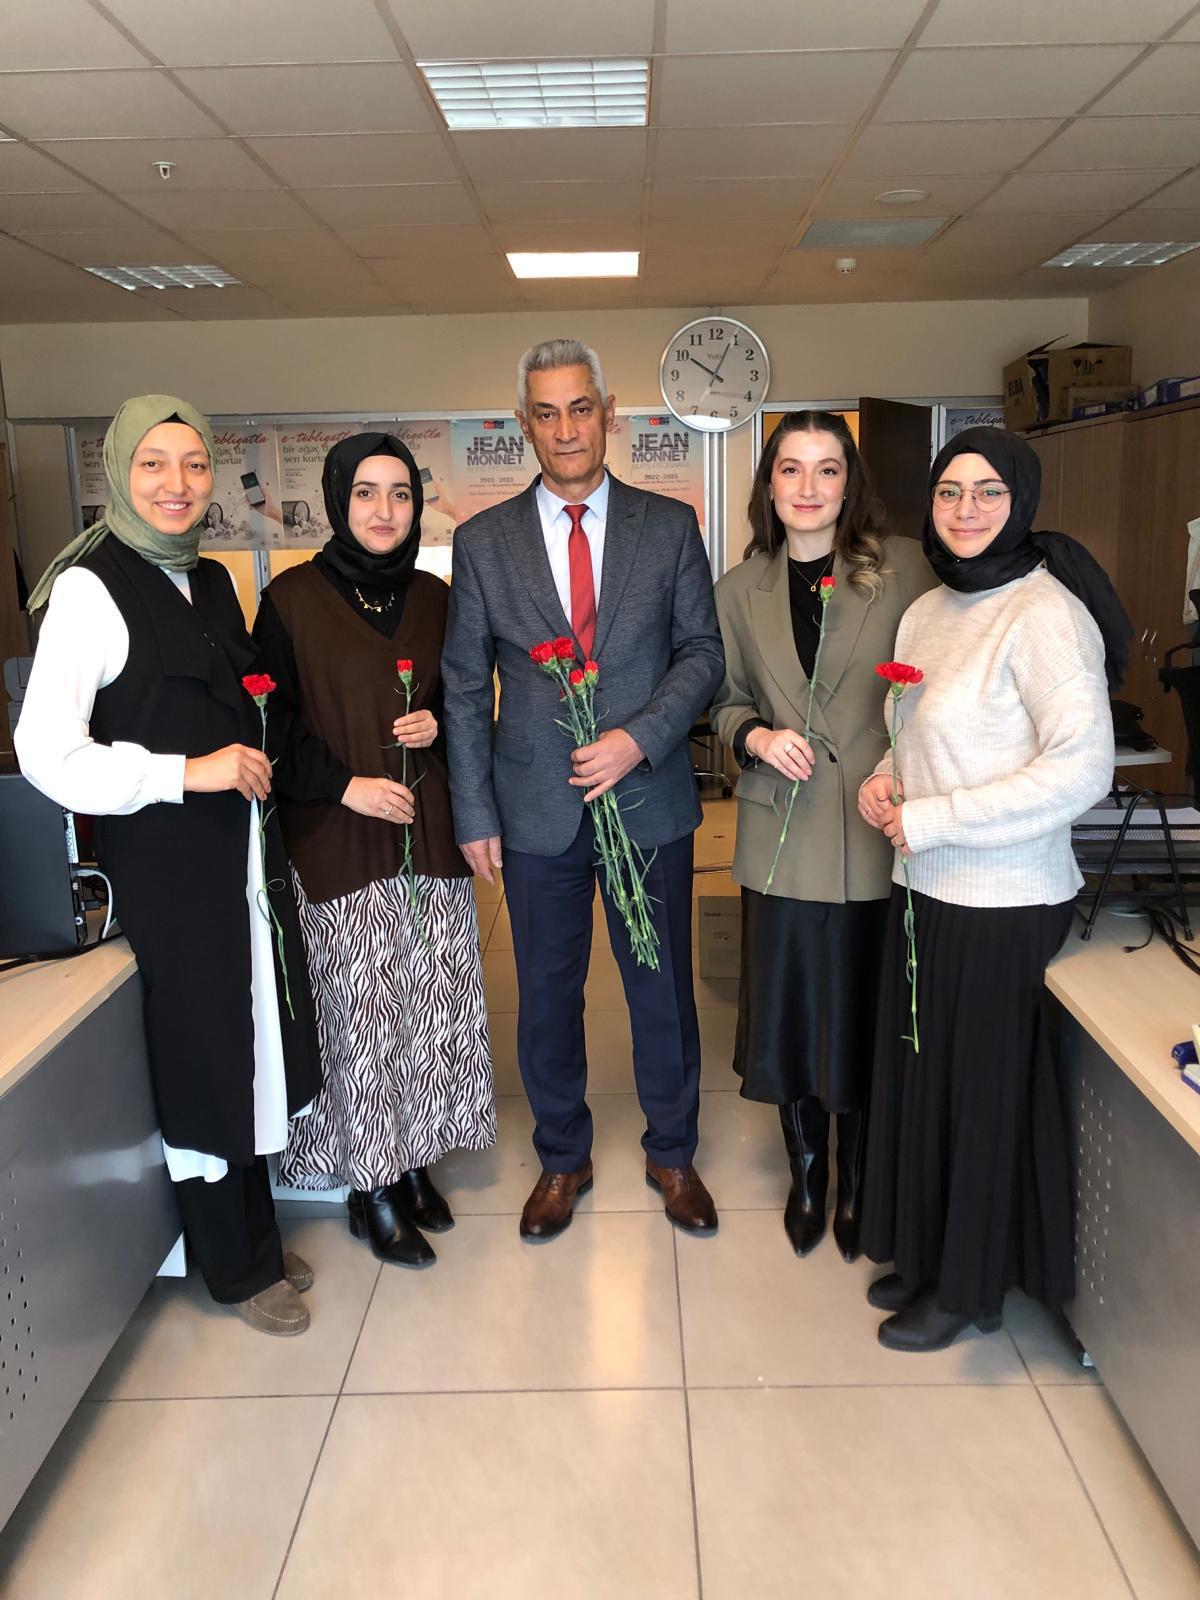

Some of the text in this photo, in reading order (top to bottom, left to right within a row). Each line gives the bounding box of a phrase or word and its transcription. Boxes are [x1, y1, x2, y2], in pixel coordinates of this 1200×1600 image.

[689, 334, 703, 346] 11
[709, 328, 724, 340] 12
[733, 334, 739, 346] 1
[675, 349, 689, 361] 10
[745, 349, 754, 361] 2
[671, 369, 680, 382] 9
[750, 370, 759, 381] 3
[676, 390, 685, 401] 8
[744, 390, 753, 402] 4
[690, 406, 699, 416] 7
[729, 406, 738, 417] 5
[466, 436, 525, 455] JEAN
[631, 431, 689, 452] JEAN
[282, 446, 294, 454] bir
[466, 454, 524, 466] MONNET
[631, 450, 689, 463] MONNET
